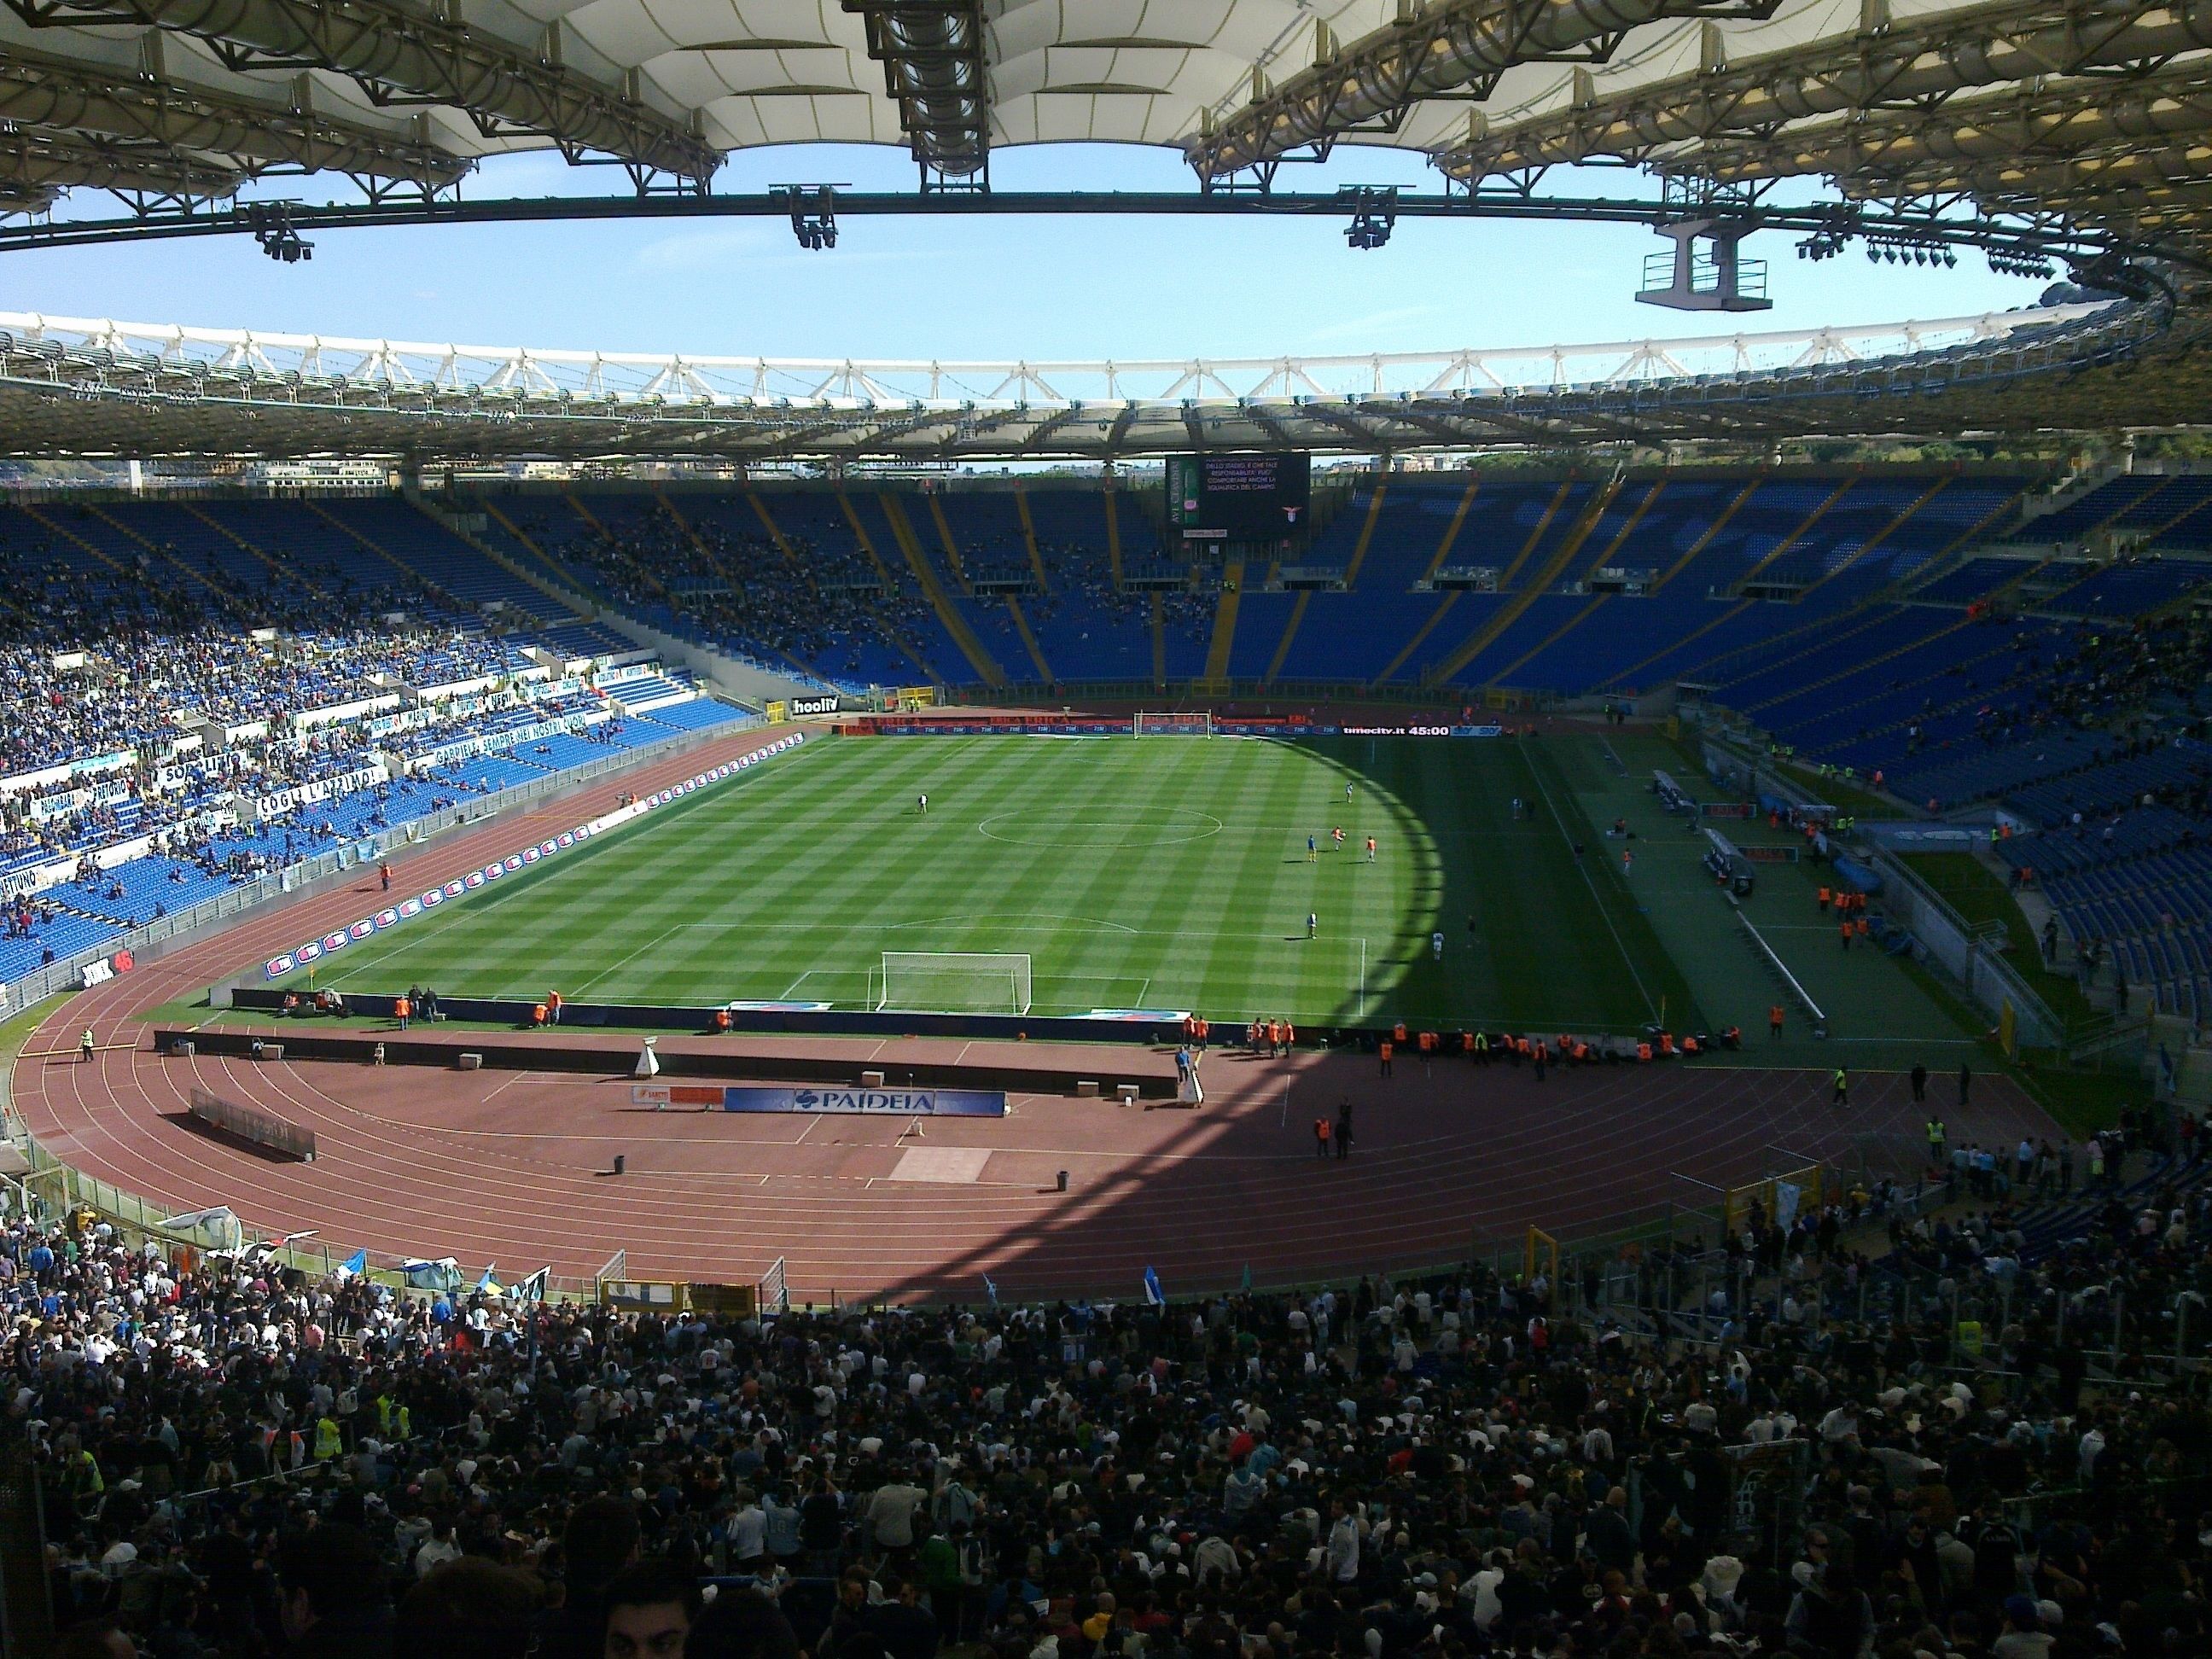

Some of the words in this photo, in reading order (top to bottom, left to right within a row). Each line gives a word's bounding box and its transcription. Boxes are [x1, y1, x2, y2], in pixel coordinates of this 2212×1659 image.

[1343, 725, 1406, 735] timecity.it
[1408, 726, 1449, 736] 45:00
[823, 1093, 934, 1110] PAIDEIA
